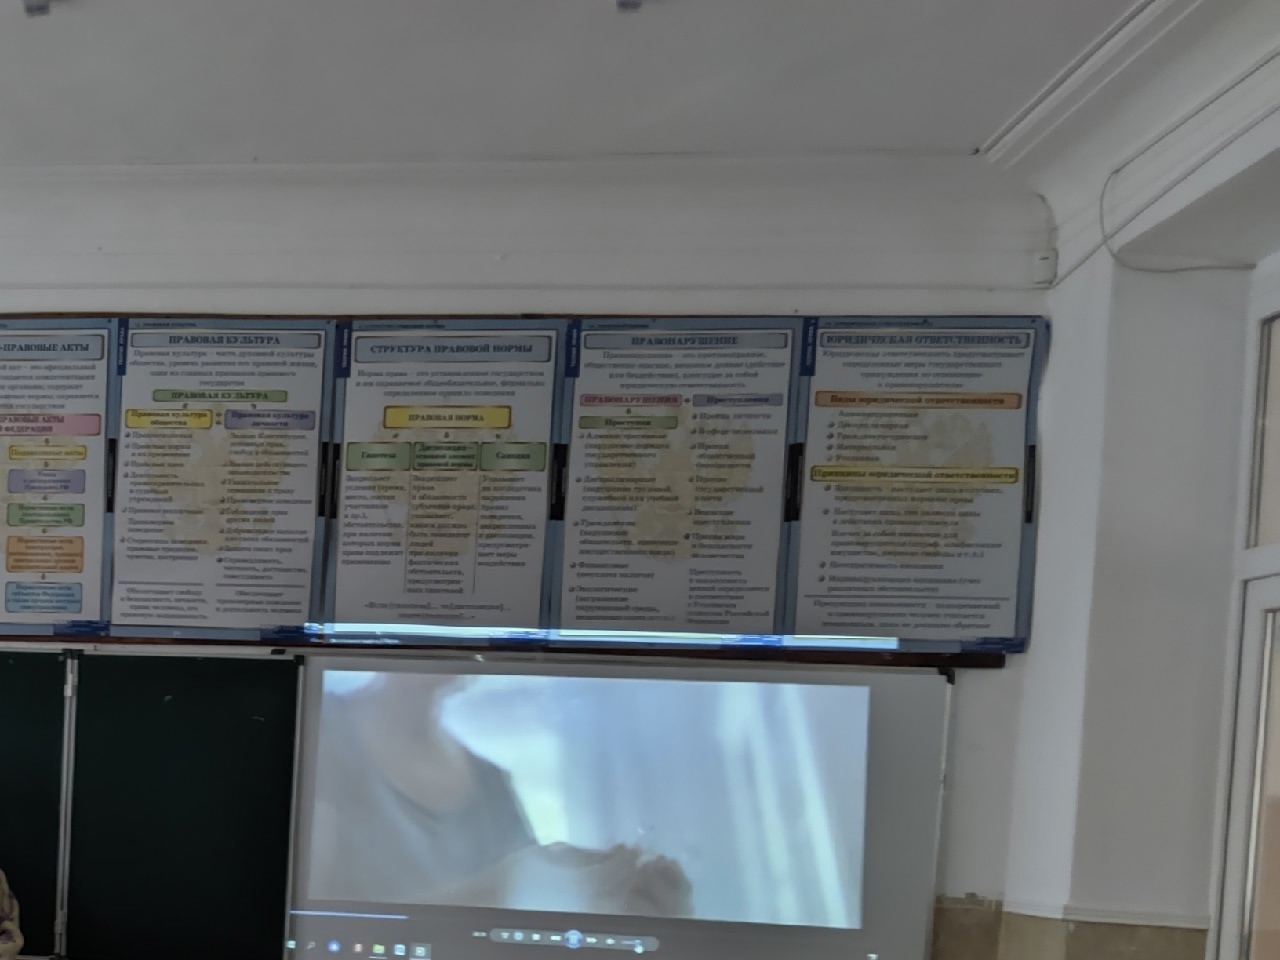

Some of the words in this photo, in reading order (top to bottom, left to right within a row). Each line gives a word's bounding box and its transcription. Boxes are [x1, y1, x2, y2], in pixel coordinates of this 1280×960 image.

[169, 335, 224, 344] ПРАВОВАЯ
[226, 336, 280, 345] КУЛЬТУРА
[631, 336, 738, 345] ПРАВОНАРУШЕНИЕ
[826, 335, 913, 344] ЮРИДИЧЕСКАЯ
[915, 336, 1022, 345] ОТВЕТСТВЕННОСТЬ
[61, 344, 89, 352] АКТЫ
[370, 345, 432, 354] СТРУКТУРА
[434, 344, 490, 353] ПРАВОВОЙ
[493, 345, 533, 353] НОРМЫ
